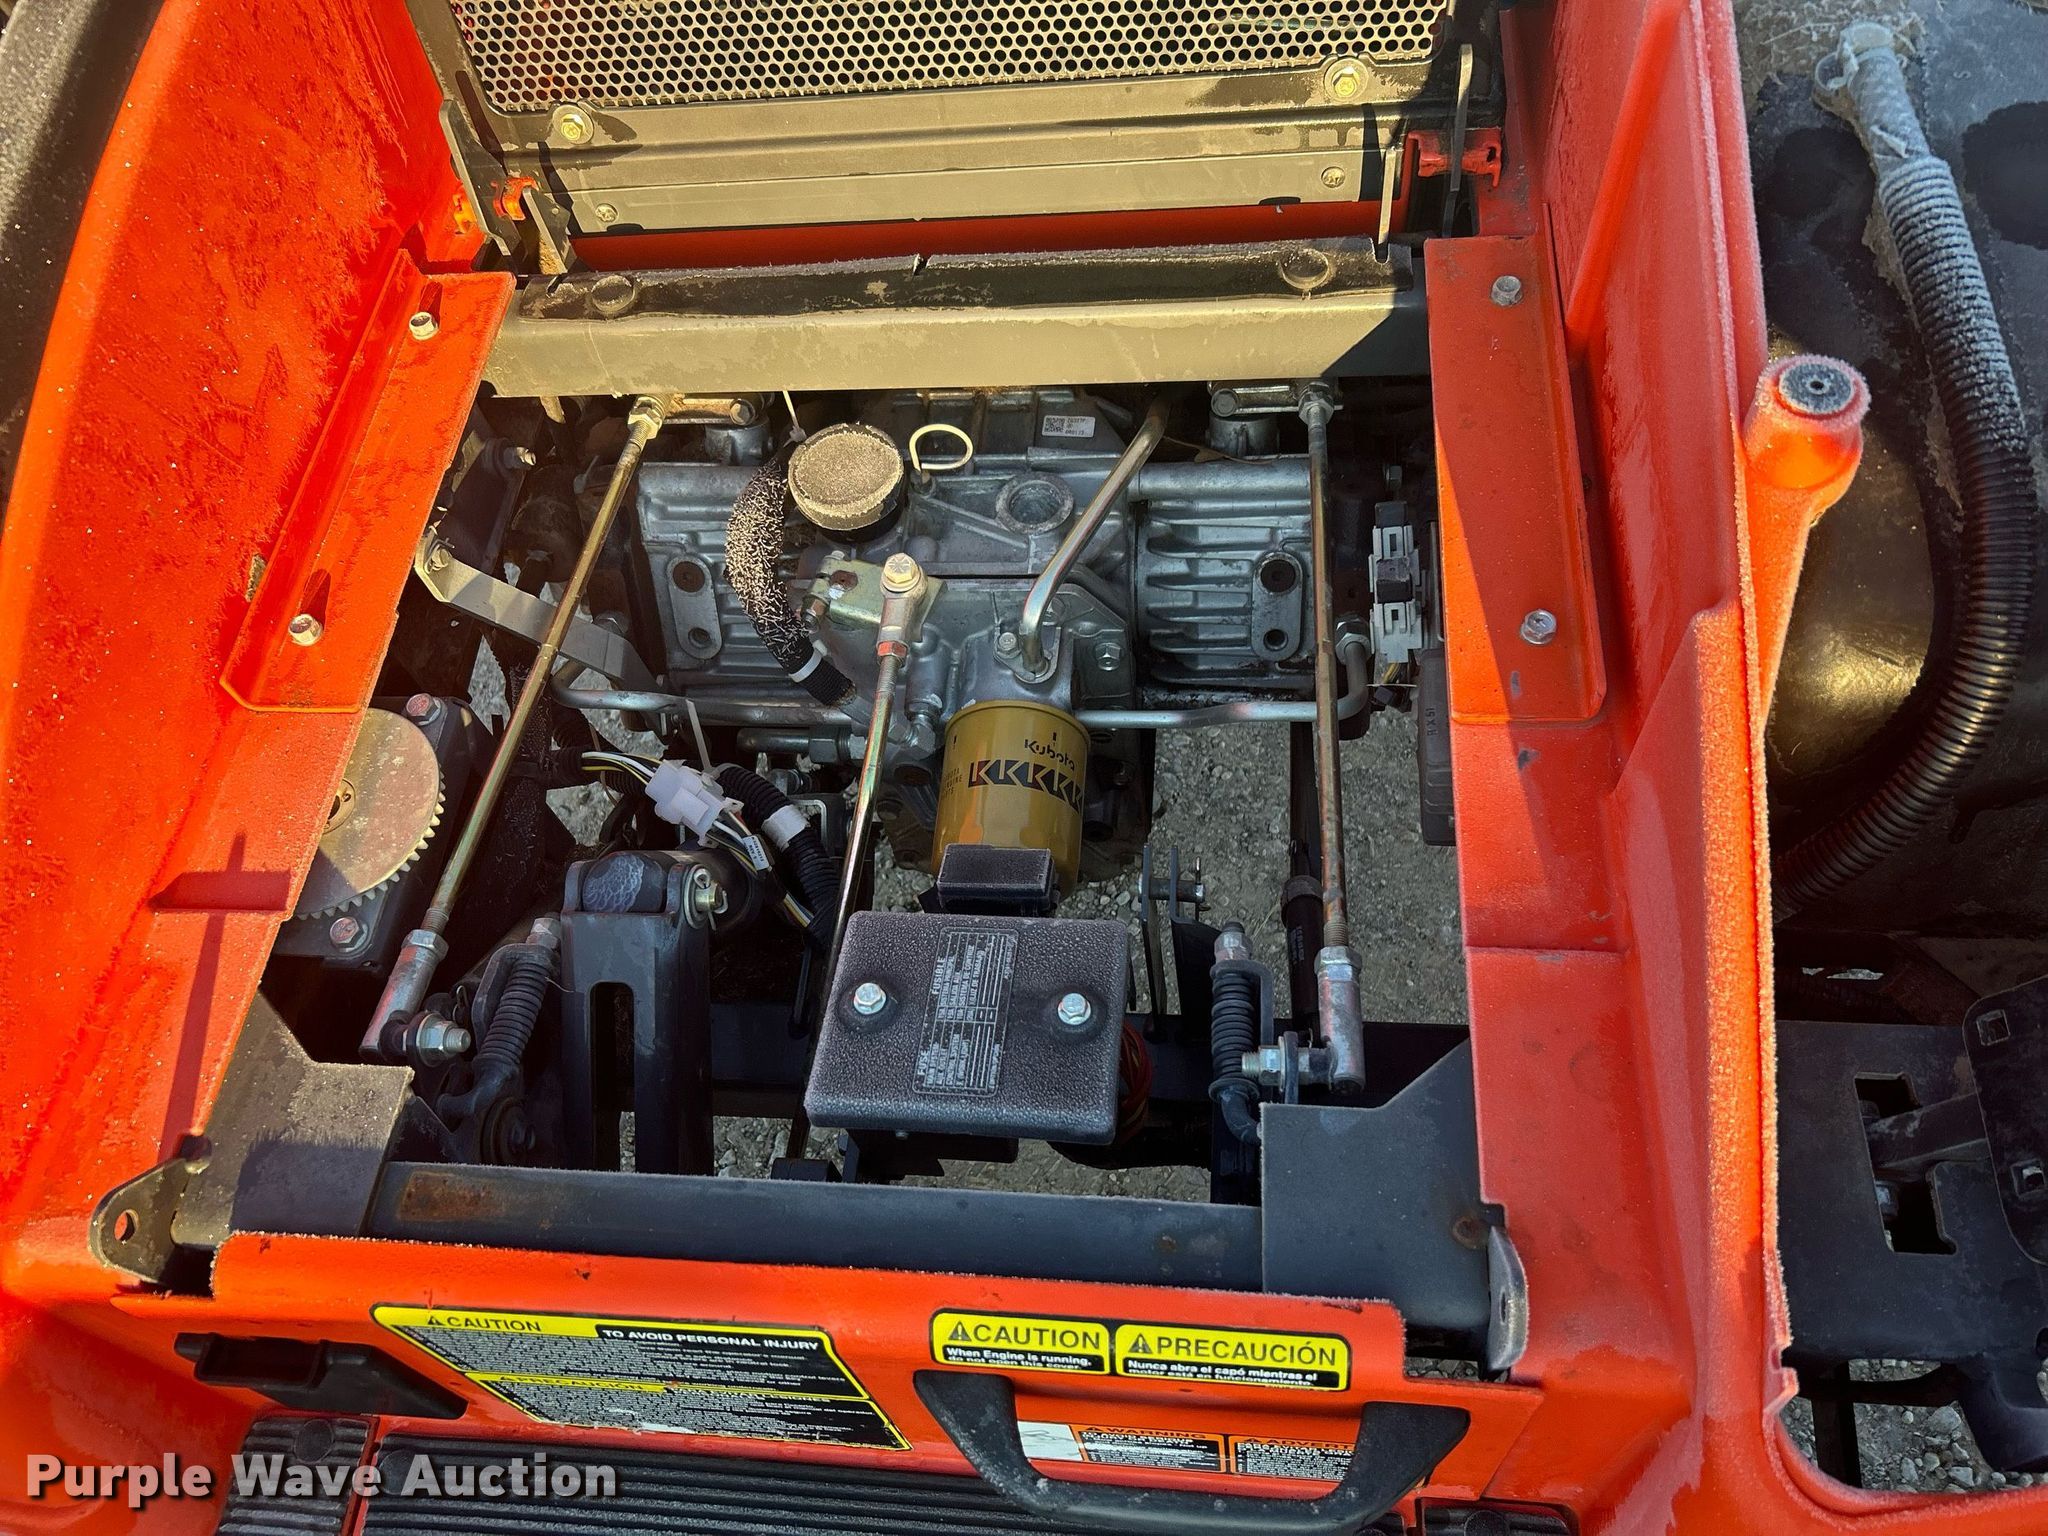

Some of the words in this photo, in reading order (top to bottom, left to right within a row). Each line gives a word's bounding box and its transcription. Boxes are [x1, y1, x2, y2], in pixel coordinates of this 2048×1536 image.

[1024, 739, 1075, 771] Kubota
[931, 956, 945, 994] FUSIBLE
[958, 979, 969, 1005] SISTEMA
[916, 1049, 928, 1075] FUSE
[447, 1316, 542, 1333] CAUTION
[973, 1323, 1101, 1349] CAUTION
[602, 1329, 624, 1338] TO
[628, 1331, 673, 1341] AVOID
[677, 1334, 761, 1348] PERSONAL
[764, 1339, 819, 1351] INJURY
[1157, 1337, 1337, 1367] PRECAUCIÓN
[947, 1347, 980, 1357] When
[983, 1350, 1024, 1360] Engine
[1028, 1353, 1038, 1361] is
[1128, 1360, 1168, 1370] Nunca
[1170, 1363, 1197, 1372] abra
[1200, 1365, 1212, 1373] el
[1215, 1367, 1246, 1376] capó
[1248, 1369, 1303, 1380] mientras
[1305, 1372, 1317, 1381] el
[1106, 1427, 1207, 1439] WARNING
[1269, 1440, 1355, 1450] ADVERT
